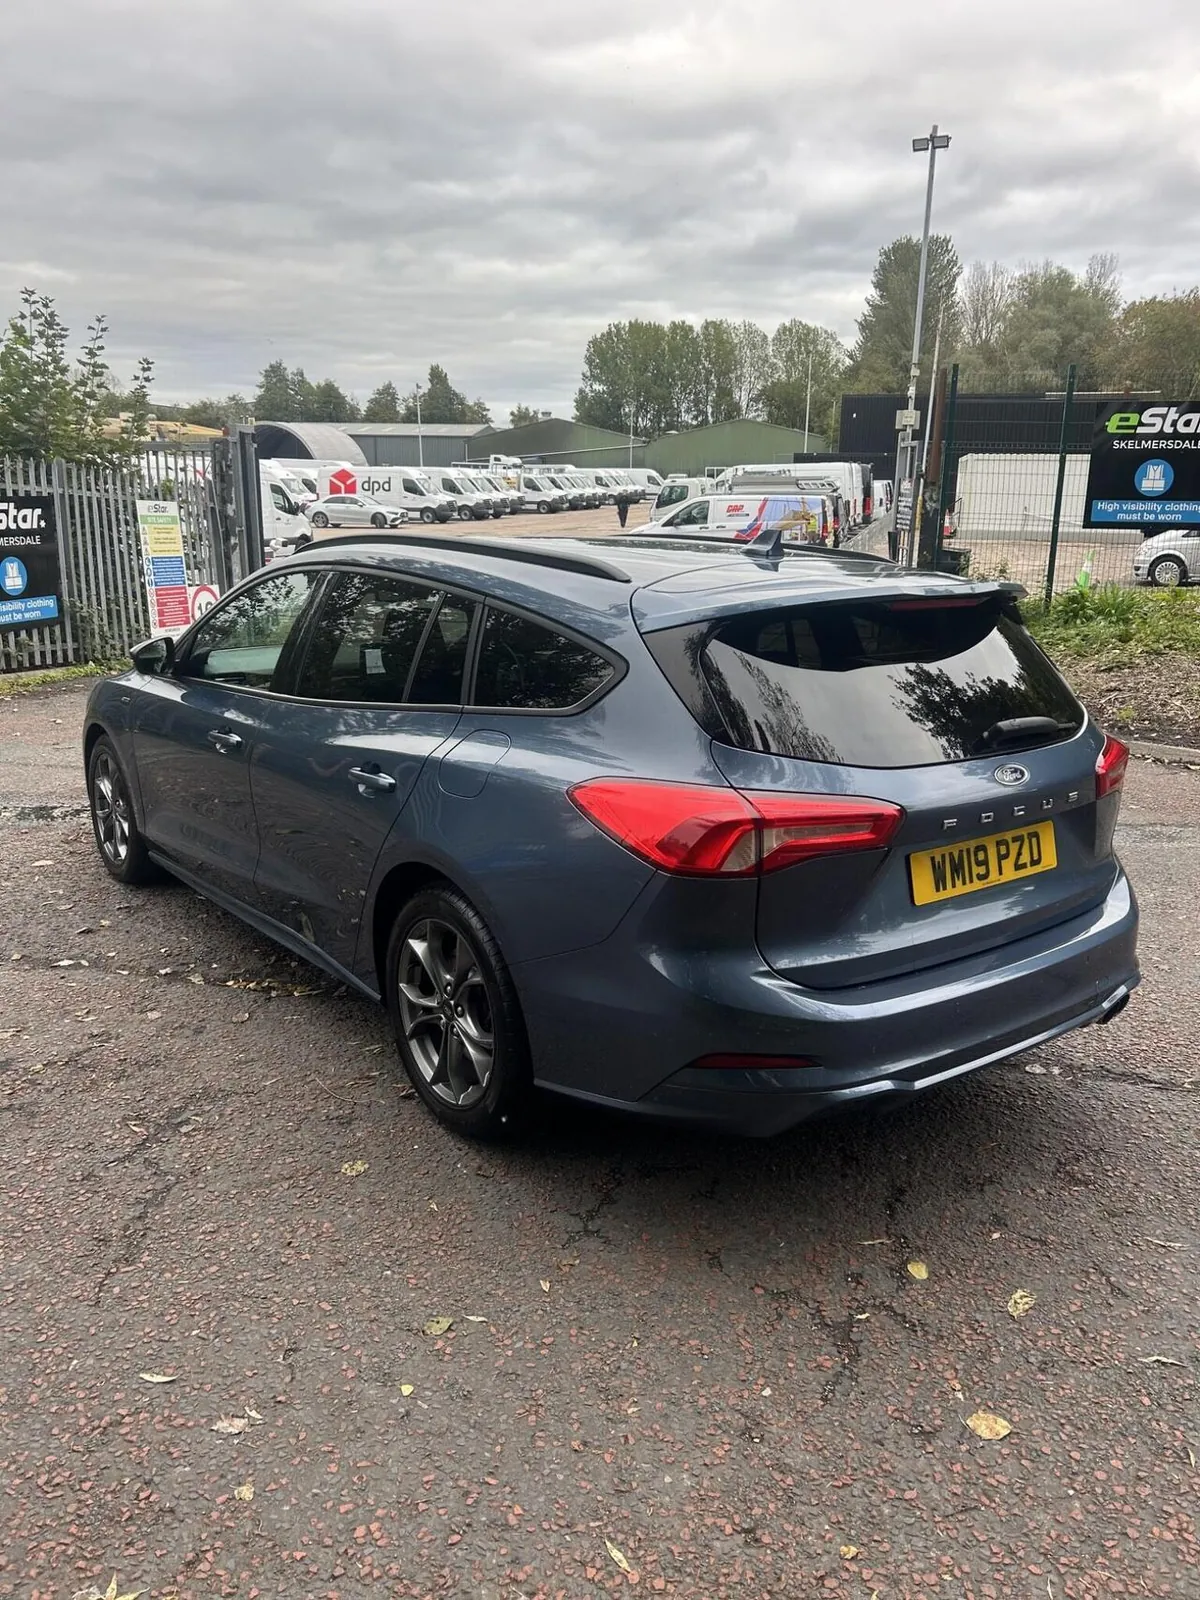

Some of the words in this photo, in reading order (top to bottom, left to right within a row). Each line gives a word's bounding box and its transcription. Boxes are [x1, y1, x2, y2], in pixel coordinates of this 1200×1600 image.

[361, 476, 391, 495] dpd
[1097, 502, 1120, 512] High
[1122, 502, 1163, 513] visibility
[1116, 512, 1141, 521] must
[1143, 512, 1155, 521] be
[1157, 513, 1182, 521] worn
[26, 598, 54, 608] clothing
[0, 613, 12, 622] ust
[13, 612, 23, 620] be
[23, 610, 41, 619] worn
[943, 791, 1079, 830] FOCUS
[930, 844, 991, 893] WM19
[995, 831, 1042, 876] PZD
